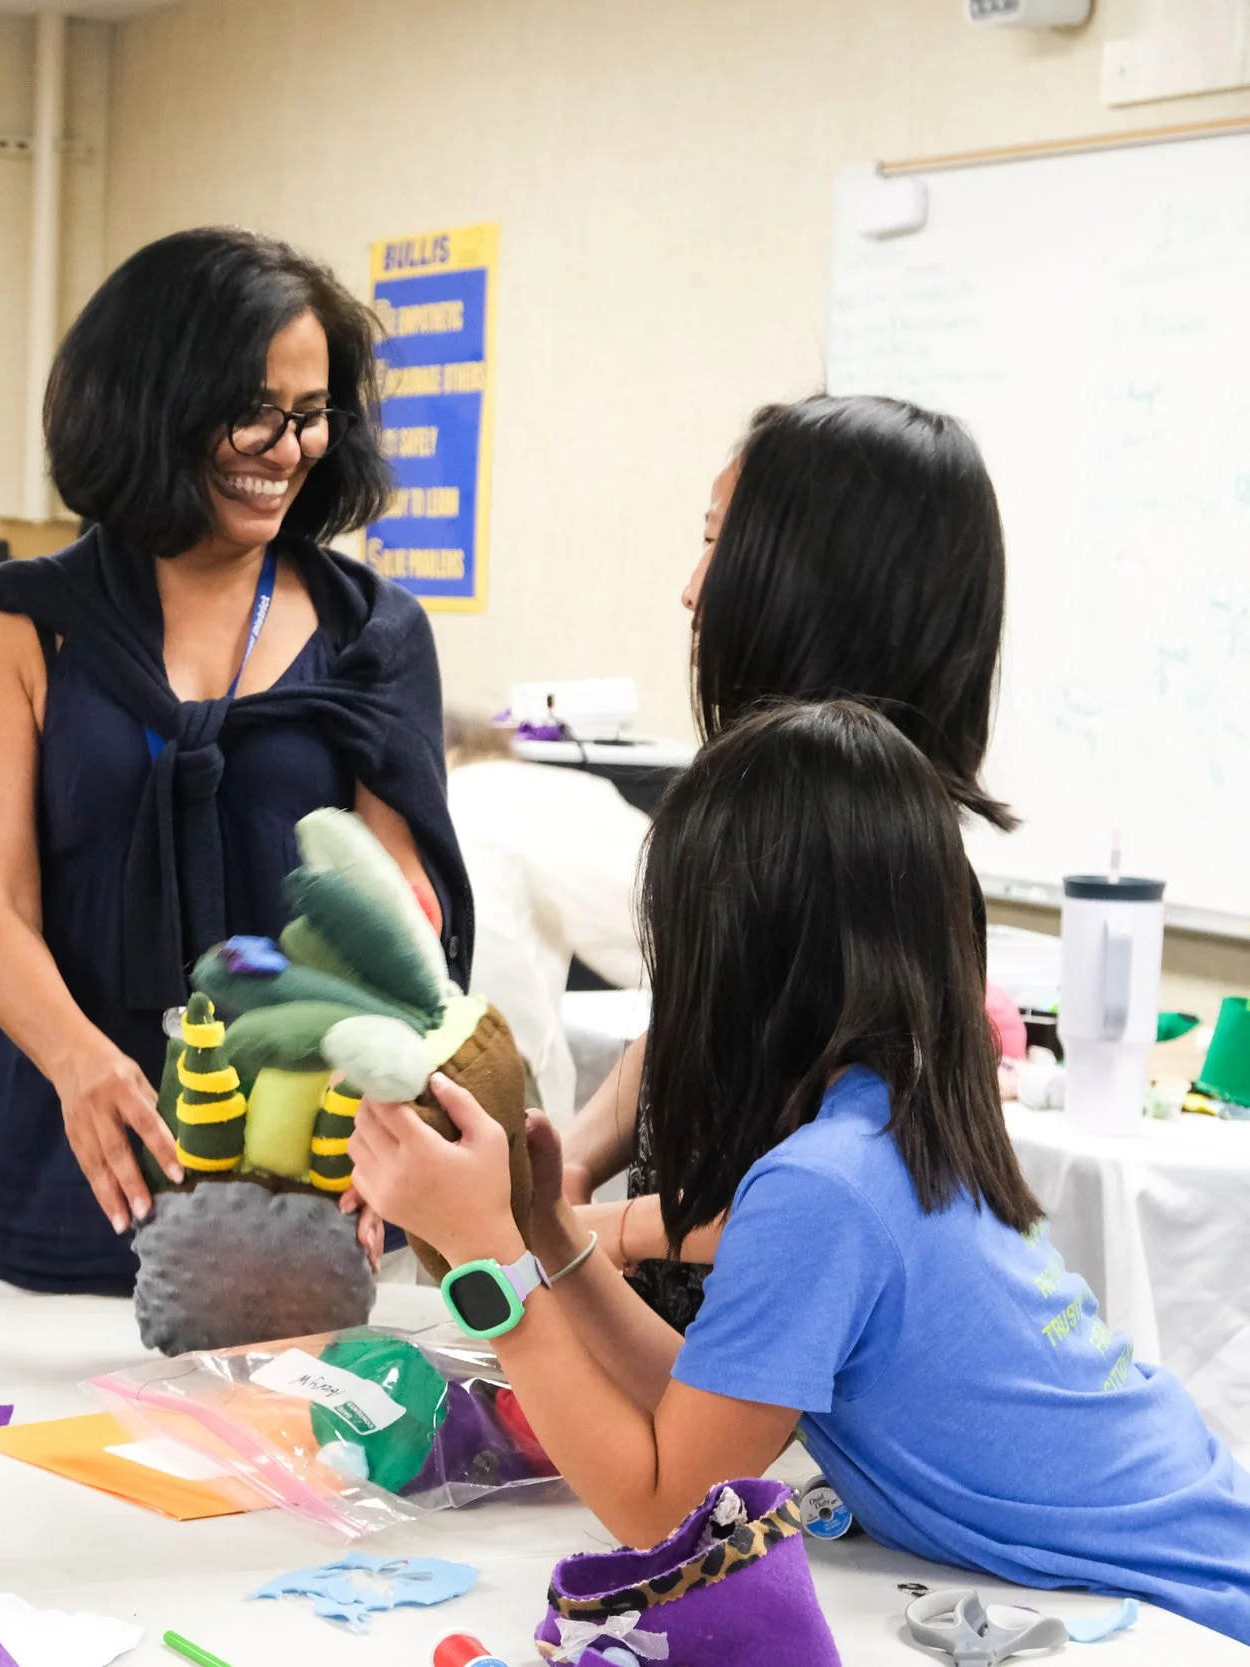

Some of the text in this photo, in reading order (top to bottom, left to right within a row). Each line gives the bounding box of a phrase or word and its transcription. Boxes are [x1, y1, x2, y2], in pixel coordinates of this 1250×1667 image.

[383, 234, 450, 272] BULLIS
[809, 1492, 825, 1505] Dual
[814, 1499, 831, 1510] Duty
